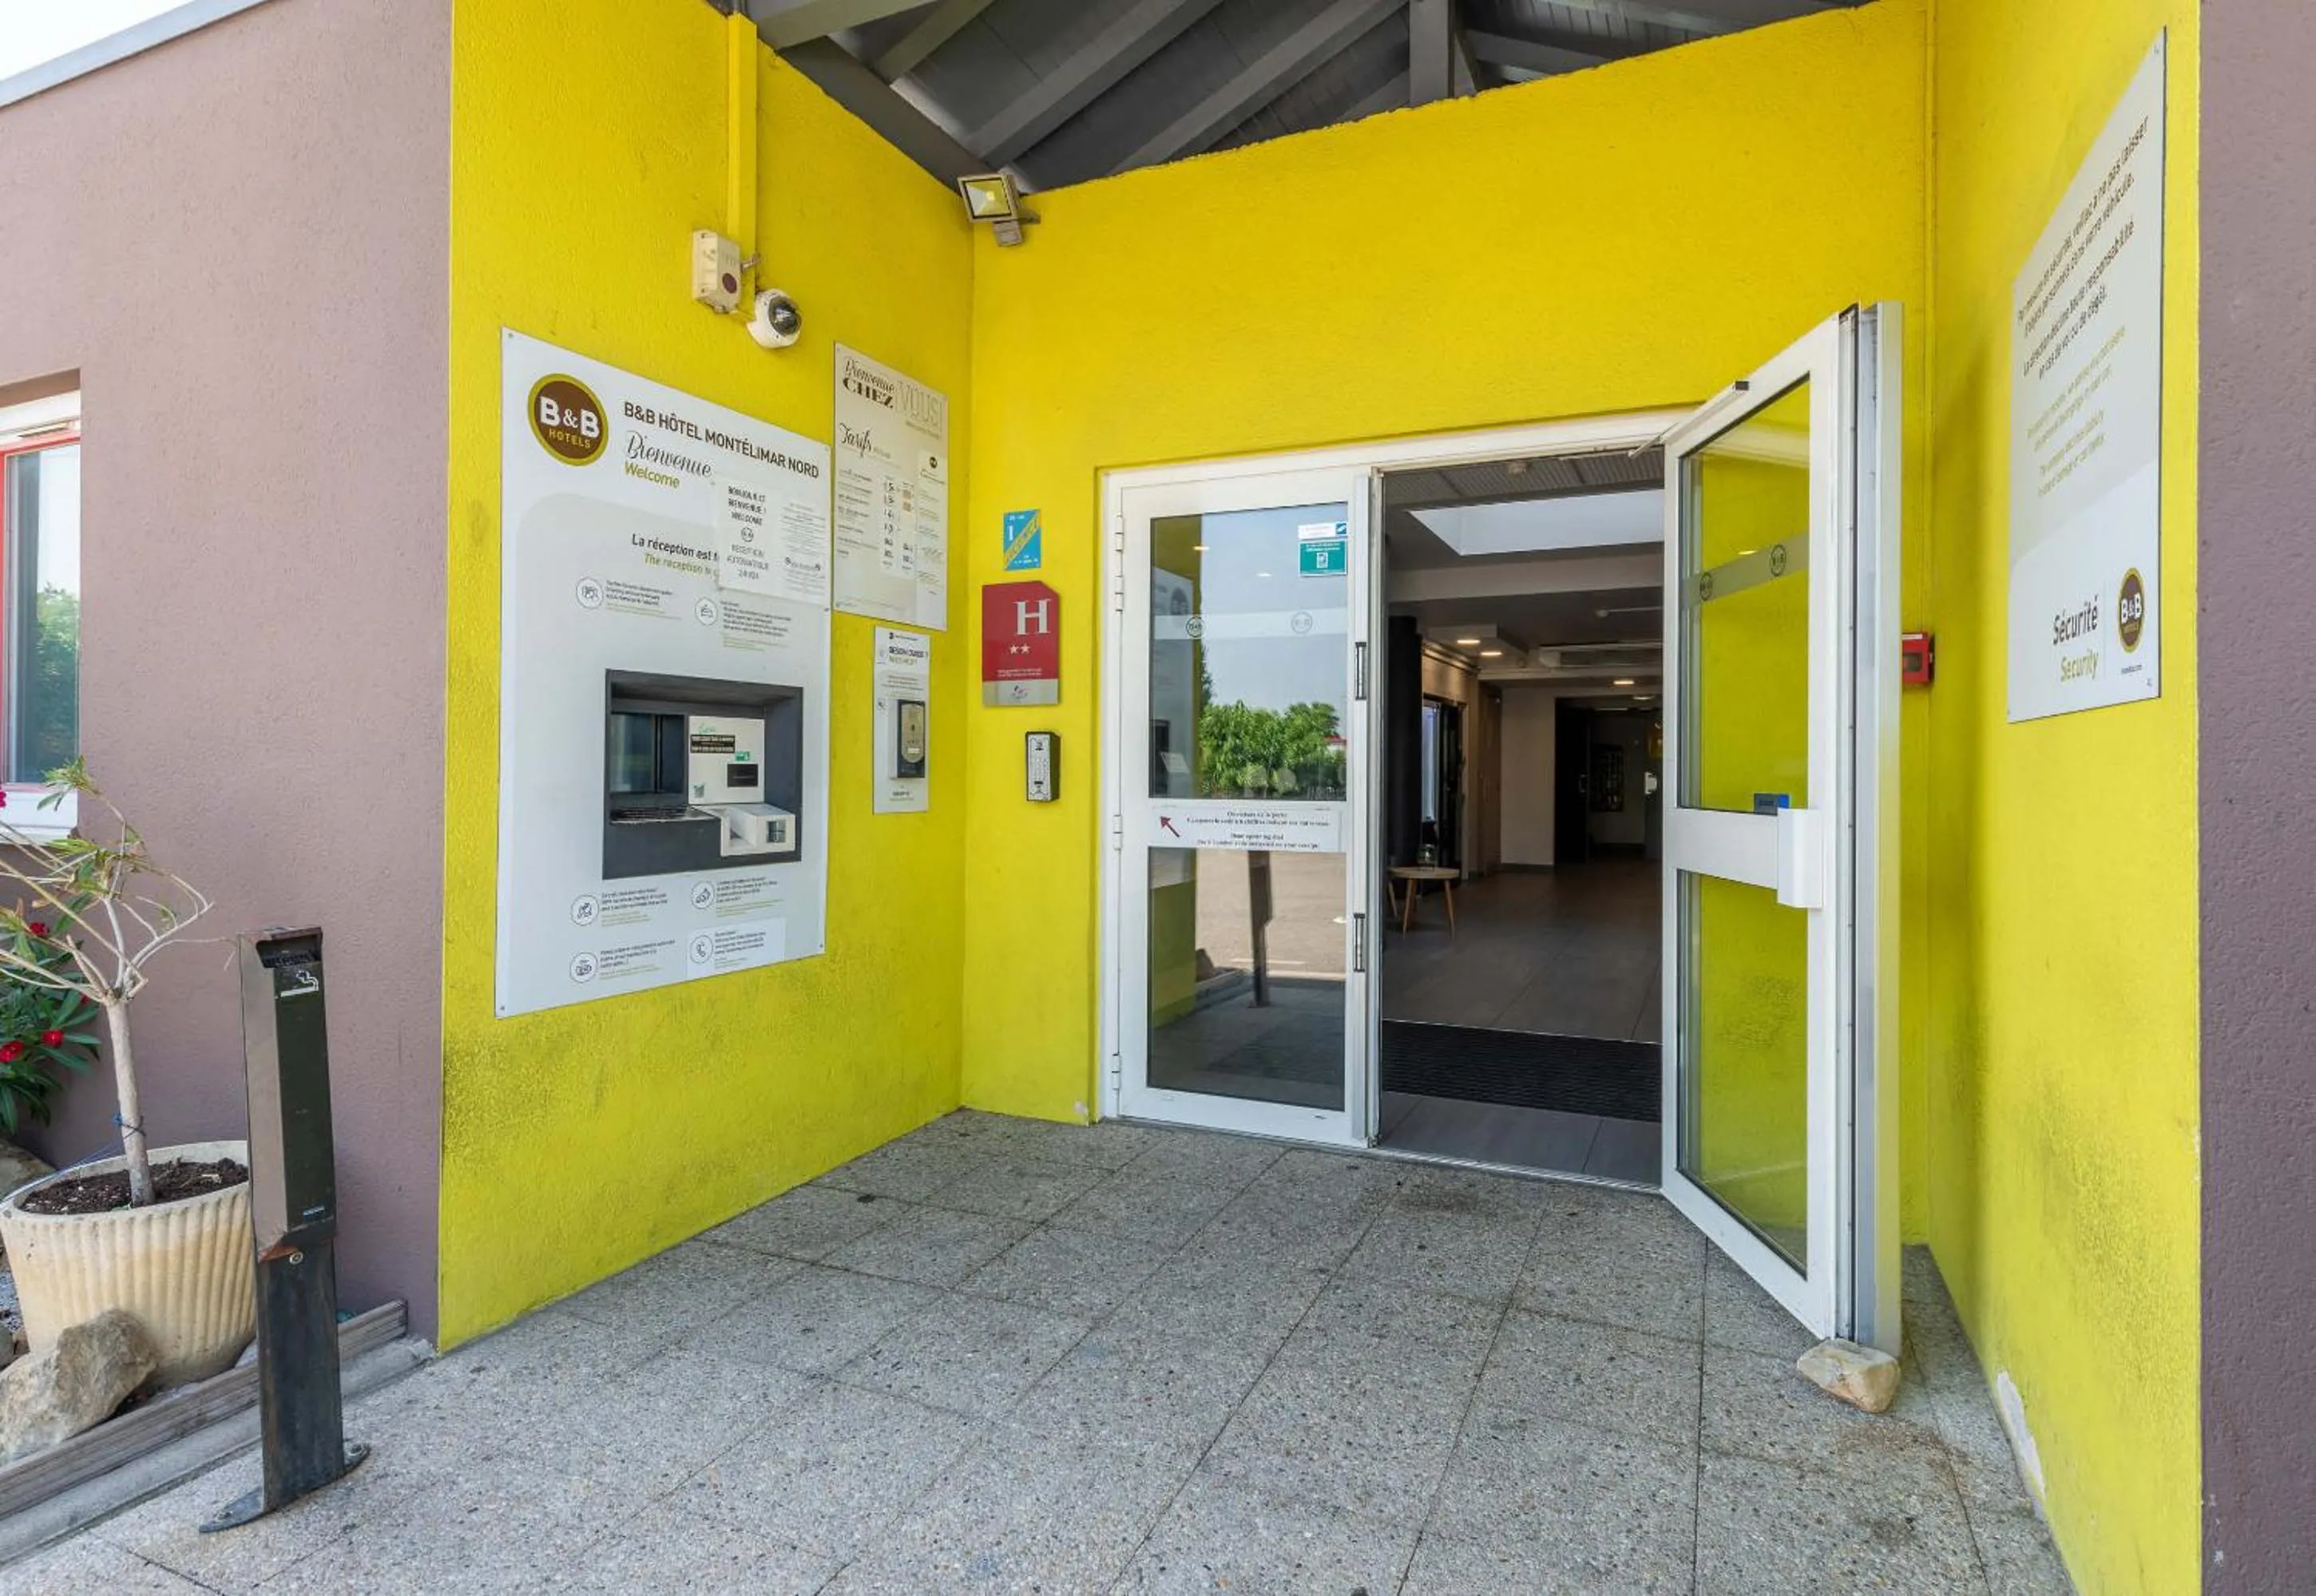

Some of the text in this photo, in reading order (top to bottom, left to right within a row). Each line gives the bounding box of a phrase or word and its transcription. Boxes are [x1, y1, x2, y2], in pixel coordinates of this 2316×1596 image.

[843, 378, 894, 409] CHEZ
[539, 396, 601, 438] B&B
[549, 428, 592, 449] HOTELS
[624, 402, 819, 479] B&B HÔTEL MONTÉLIMAR NORD
[625, 430, 713, 479] Bienvenue
[624, 461, 680, 489] Welcome
[632, 533, 644, 546] La
[648, 537, 694, 557] réception
[696, 550, 712, 560] est
[643, 552, 661, 565] The
[663, 558, 703, 575] reception
[1013, 598, 1052, 636] H
[2052, 592, 2142, 645] Sécurité B&B
[2061, 648, 2099, 682] Security
